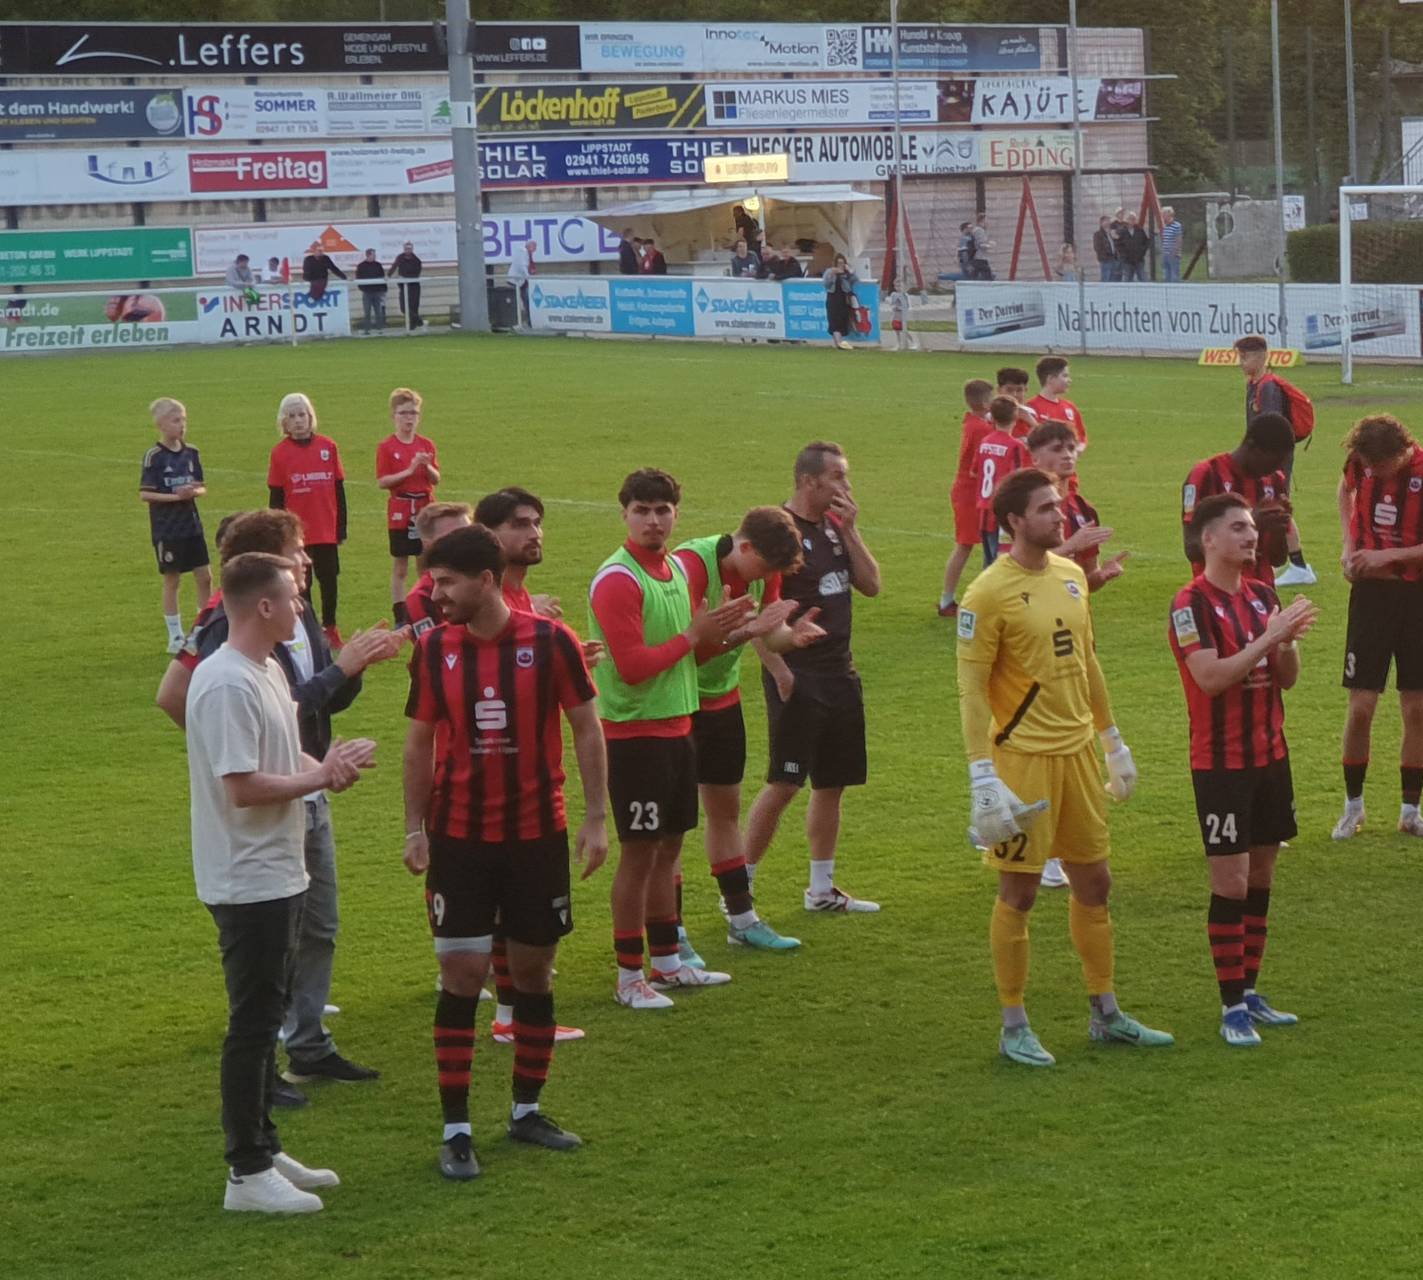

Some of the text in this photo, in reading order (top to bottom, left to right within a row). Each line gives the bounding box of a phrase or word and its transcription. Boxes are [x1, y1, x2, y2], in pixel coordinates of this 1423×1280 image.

[601, 45, 685, 59] BEWEGUNG
[769, 42, 819, 54] Motion
[254, 98, 317, 113] SOMMER
[500, 86, 621, 122] Löckenhoff
[738, 88, 849, 105] MARKUS MIES
[8, 102, 45, 116] dem
[48, 100, 135, 115] Handwerk!
[738, 106, 850, 121] Fliesenlegermeister
[581, 143, 632, 153] LIPPSTADT
[667, 141, 740, 157] THIEL
[749, 134, 917, 163] HECKER AUTOMOBLE
[236, 156, 324, 184] Freitag
[565, 152, 650, 167] 02941 7426056
[567, 165, 649, 177] www.thiel-solar.de
[481, 218, 585, 258] BHTC
[710, 289, 782, 314] STAKEMEIER
[219, 312, 328, 338] ARNDT
[1057, 301, 1164, 332] Nachrichten
[1168, 310, 1202, 333] von
[1349, 308, 1380, 323] atriot
[6, 323, 170, 349] Freizeit erleben
[1202, 349, 1293, 365] WEST TTO
[981, 458, 996, 498] 8
[629, 800, 660, 832] 23
[1206, 812, 1238, 845] 24
[433, 892, 446, 927] 9
